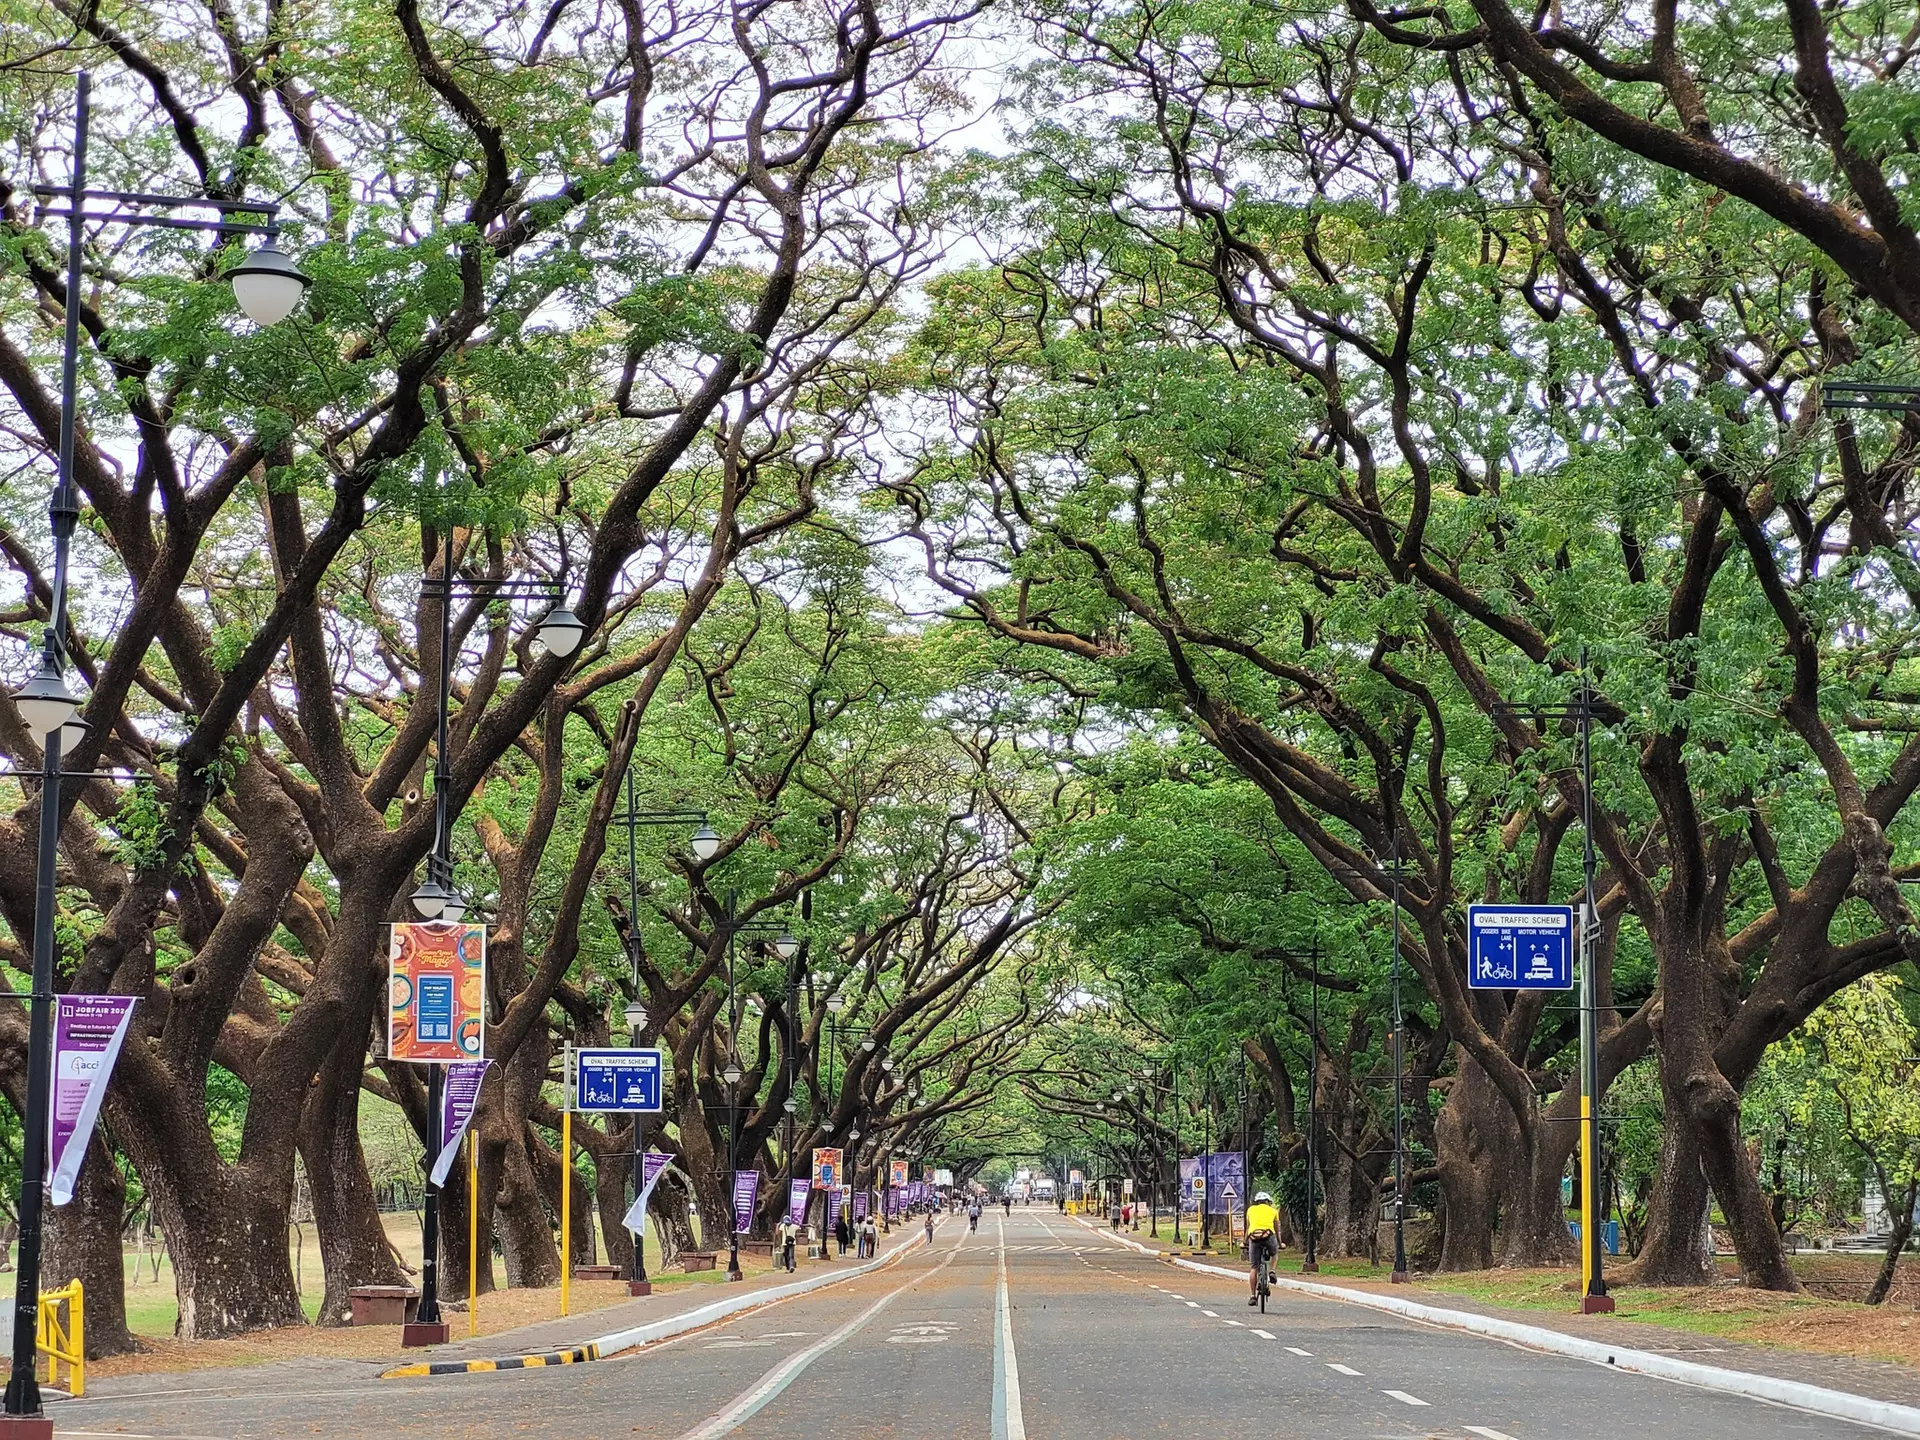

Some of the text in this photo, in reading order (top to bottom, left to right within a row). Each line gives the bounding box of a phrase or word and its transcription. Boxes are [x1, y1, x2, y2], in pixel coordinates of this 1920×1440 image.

[1479, 916, 1560, 924] OVAL TRAFFIC SCHEME
[420, 956, 450, 968] Magic
